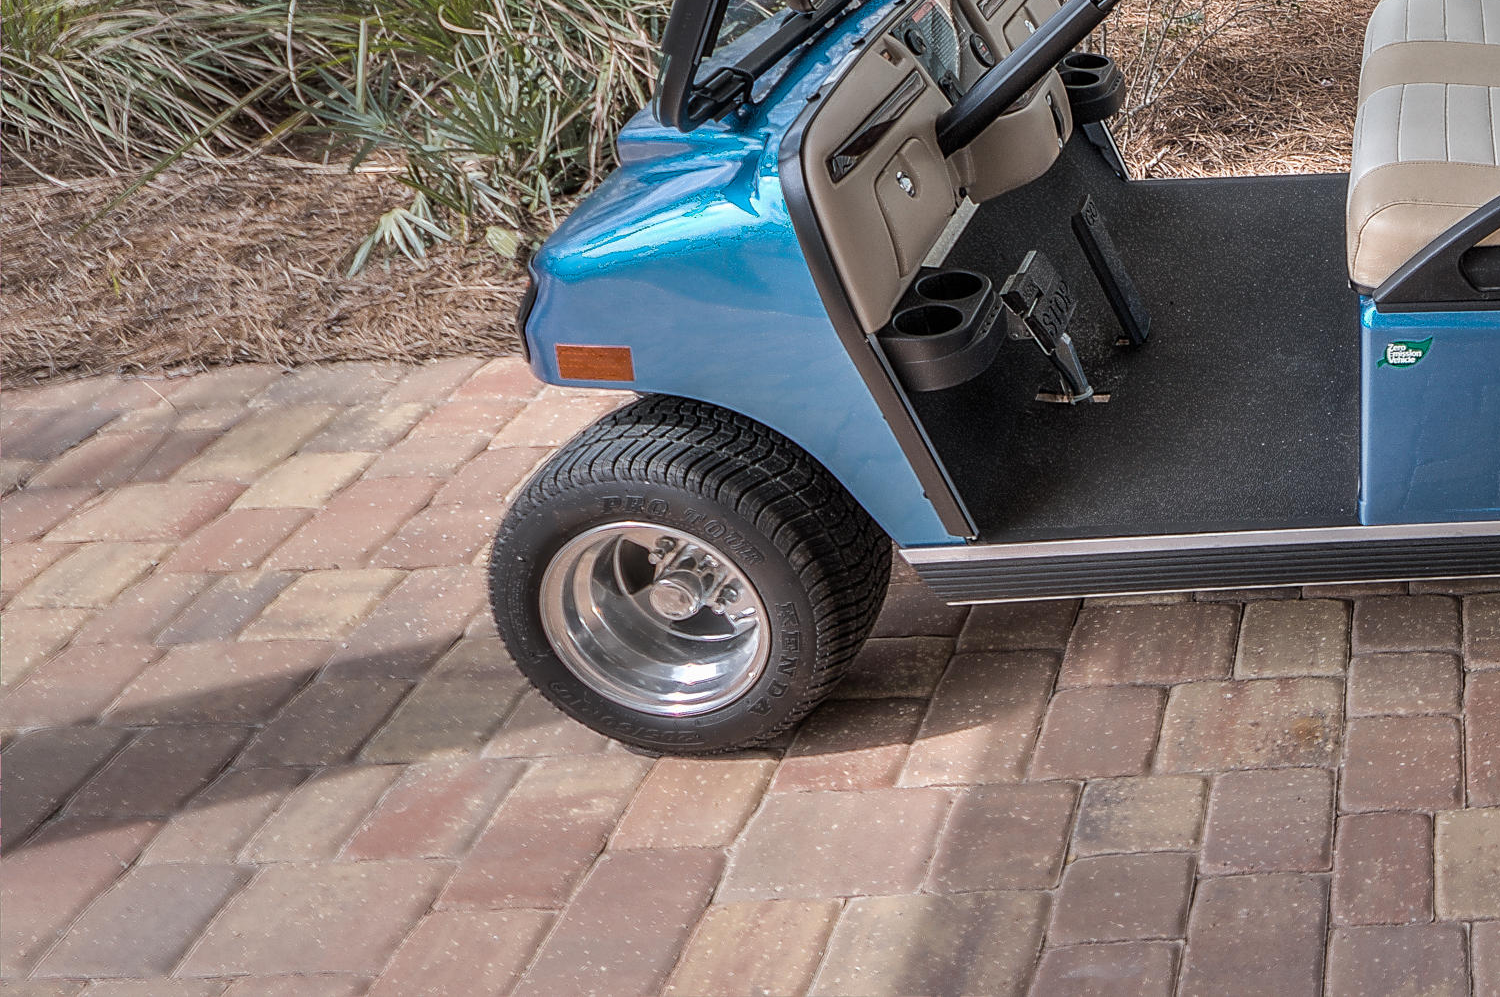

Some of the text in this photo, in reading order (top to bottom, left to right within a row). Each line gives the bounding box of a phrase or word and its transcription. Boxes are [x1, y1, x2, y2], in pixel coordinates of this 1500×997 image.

[1085, 201, 1099, 226] GO
[1042, 280, 1071, 336] STOP
[1387, 343, 1407, 352] Zero
[1387, 350, 1422, 358] Emission
[1388, 356, 1416, 364] Vehicle
[600, 494, 766, 565] PRO TOUR
[747, 602, 801, 717] KENDA
